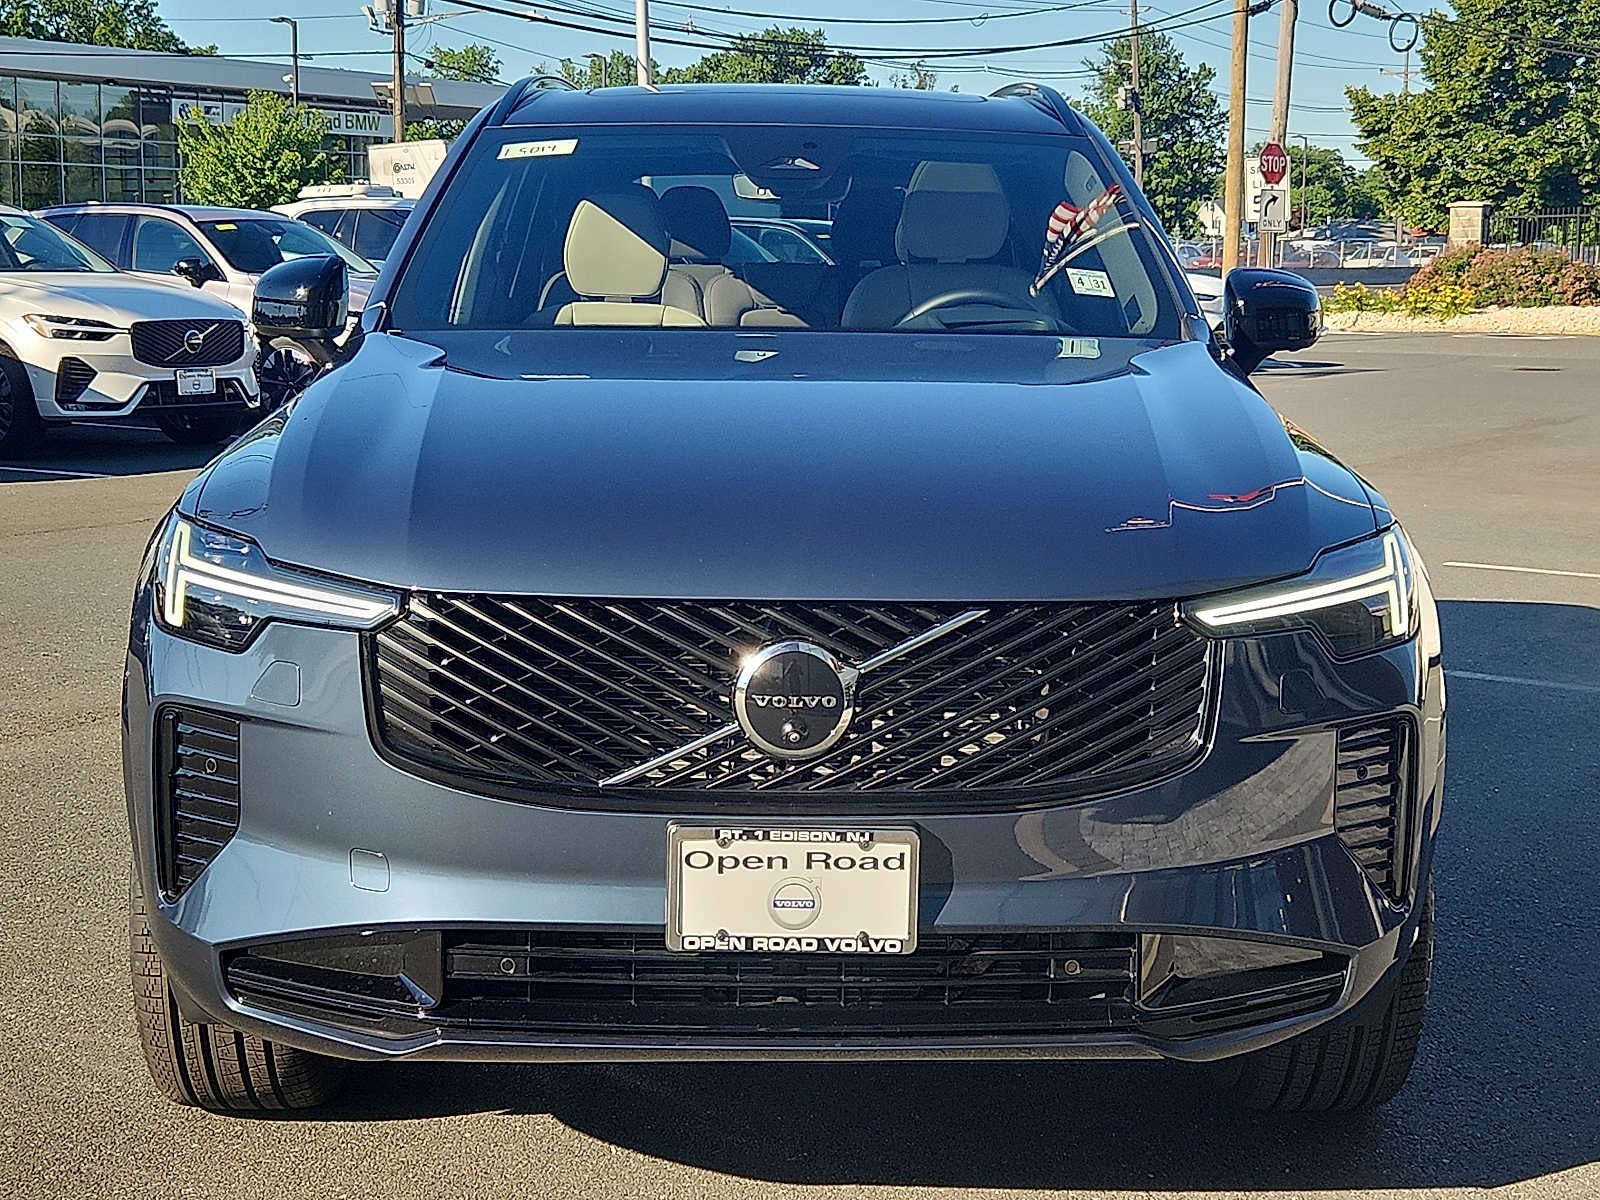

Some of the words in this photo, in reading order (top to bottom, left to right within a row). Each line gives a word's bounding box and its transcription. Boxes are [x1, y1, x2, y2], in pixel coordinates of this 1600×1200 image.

[345, 114, 380, 131] BMW
[1261, 155, 1286, 173] STOP
[1262, 219, 1282, 228] ONLY
[1092, 279, 1108, 290] 31
[751, 694, 837, 708] VOLVO
[720, 829, 748, 841] RT.
[754, 830, 764, 841] 1
[769, 830, 841, 842] EDISON,
[847, 831, 870, 842] NJ
[684, 850, 788, 875] Open
[805, 852, 905, 870] Road
[774, 900, 814, 908] VOLVO
[683, 936, 746, 951] OPEN
[752, 937, 818, 952] ROAD
[823, 938, 903, 953] VOLVO
